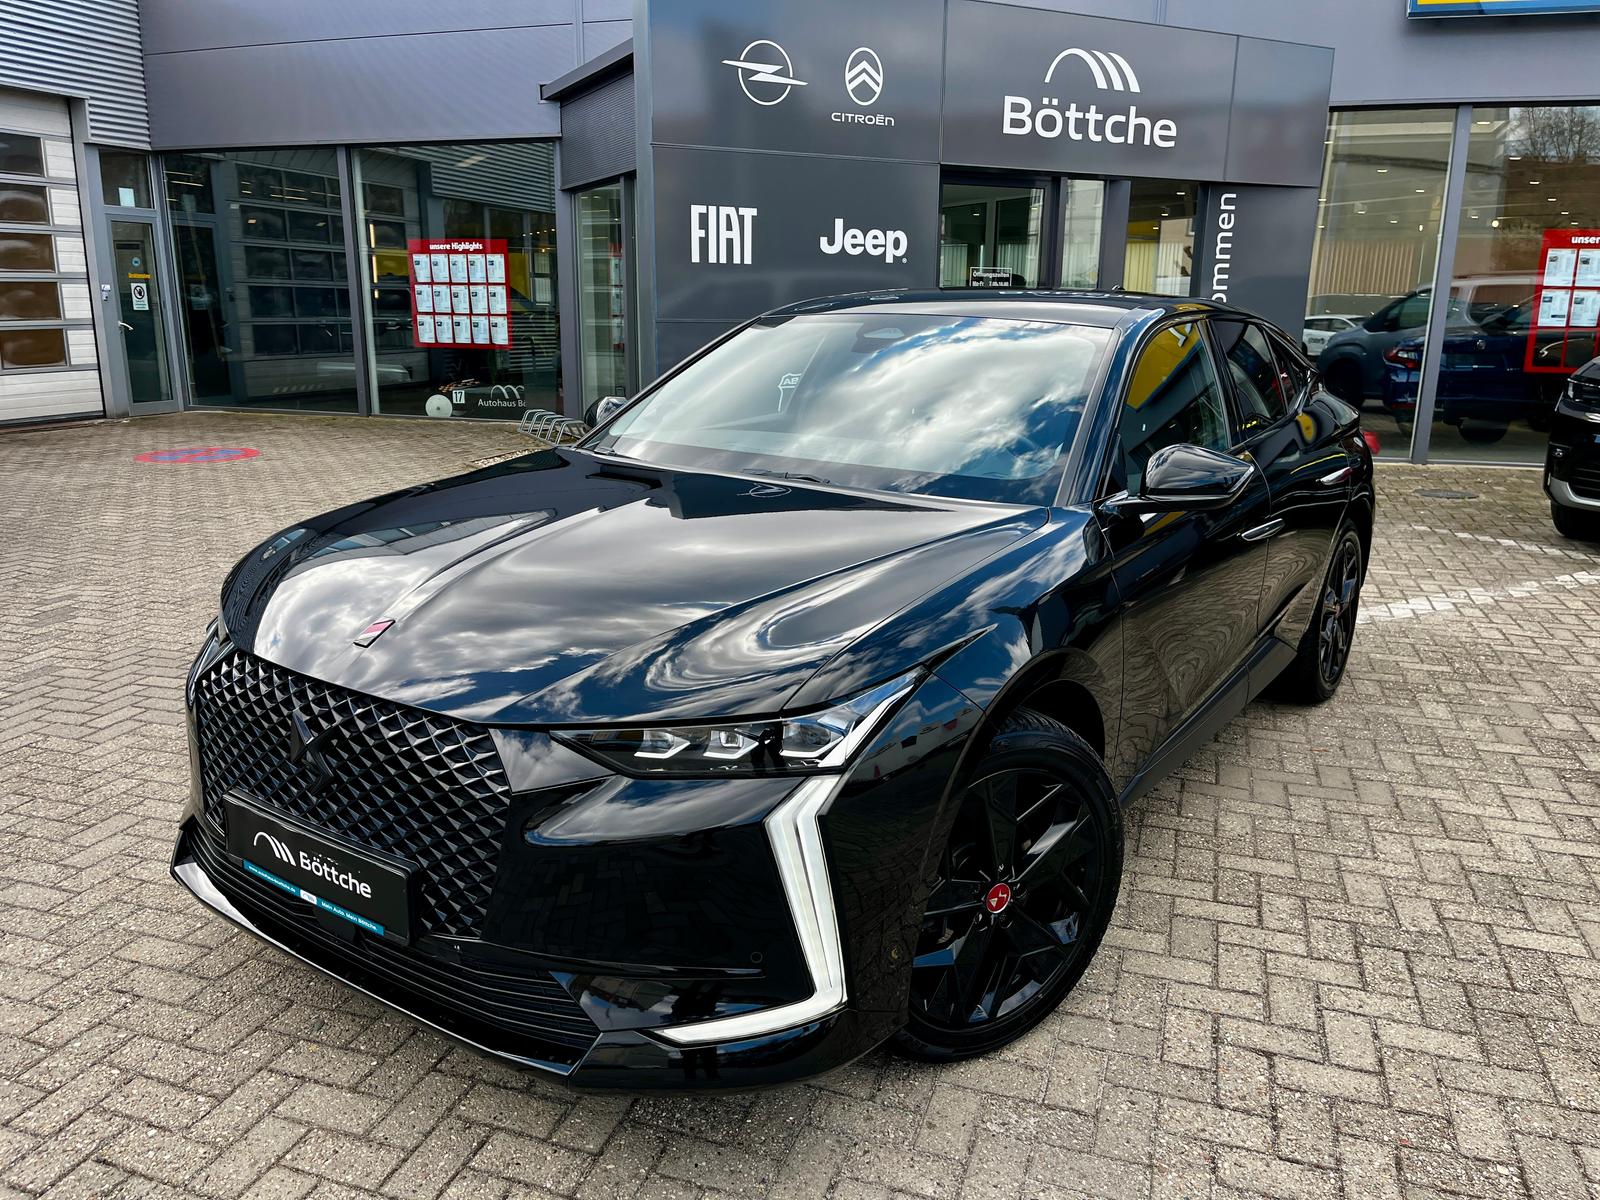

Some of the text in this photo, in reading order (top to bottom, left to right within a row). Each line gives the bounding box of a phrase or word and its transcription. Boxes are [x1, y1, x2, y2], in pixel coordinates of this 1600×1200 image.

[1002, 95, 1178, 149] Böttche
[451, 241, 483, 252] Highlights
[690, 204, 758, 265] FIAT
[819, 218, 908, 264] Jeep
[454, 391, 463, 402] 17
[478, 398, 517, 407] Autohaus
[299, 850, 372, 899] Böttche
